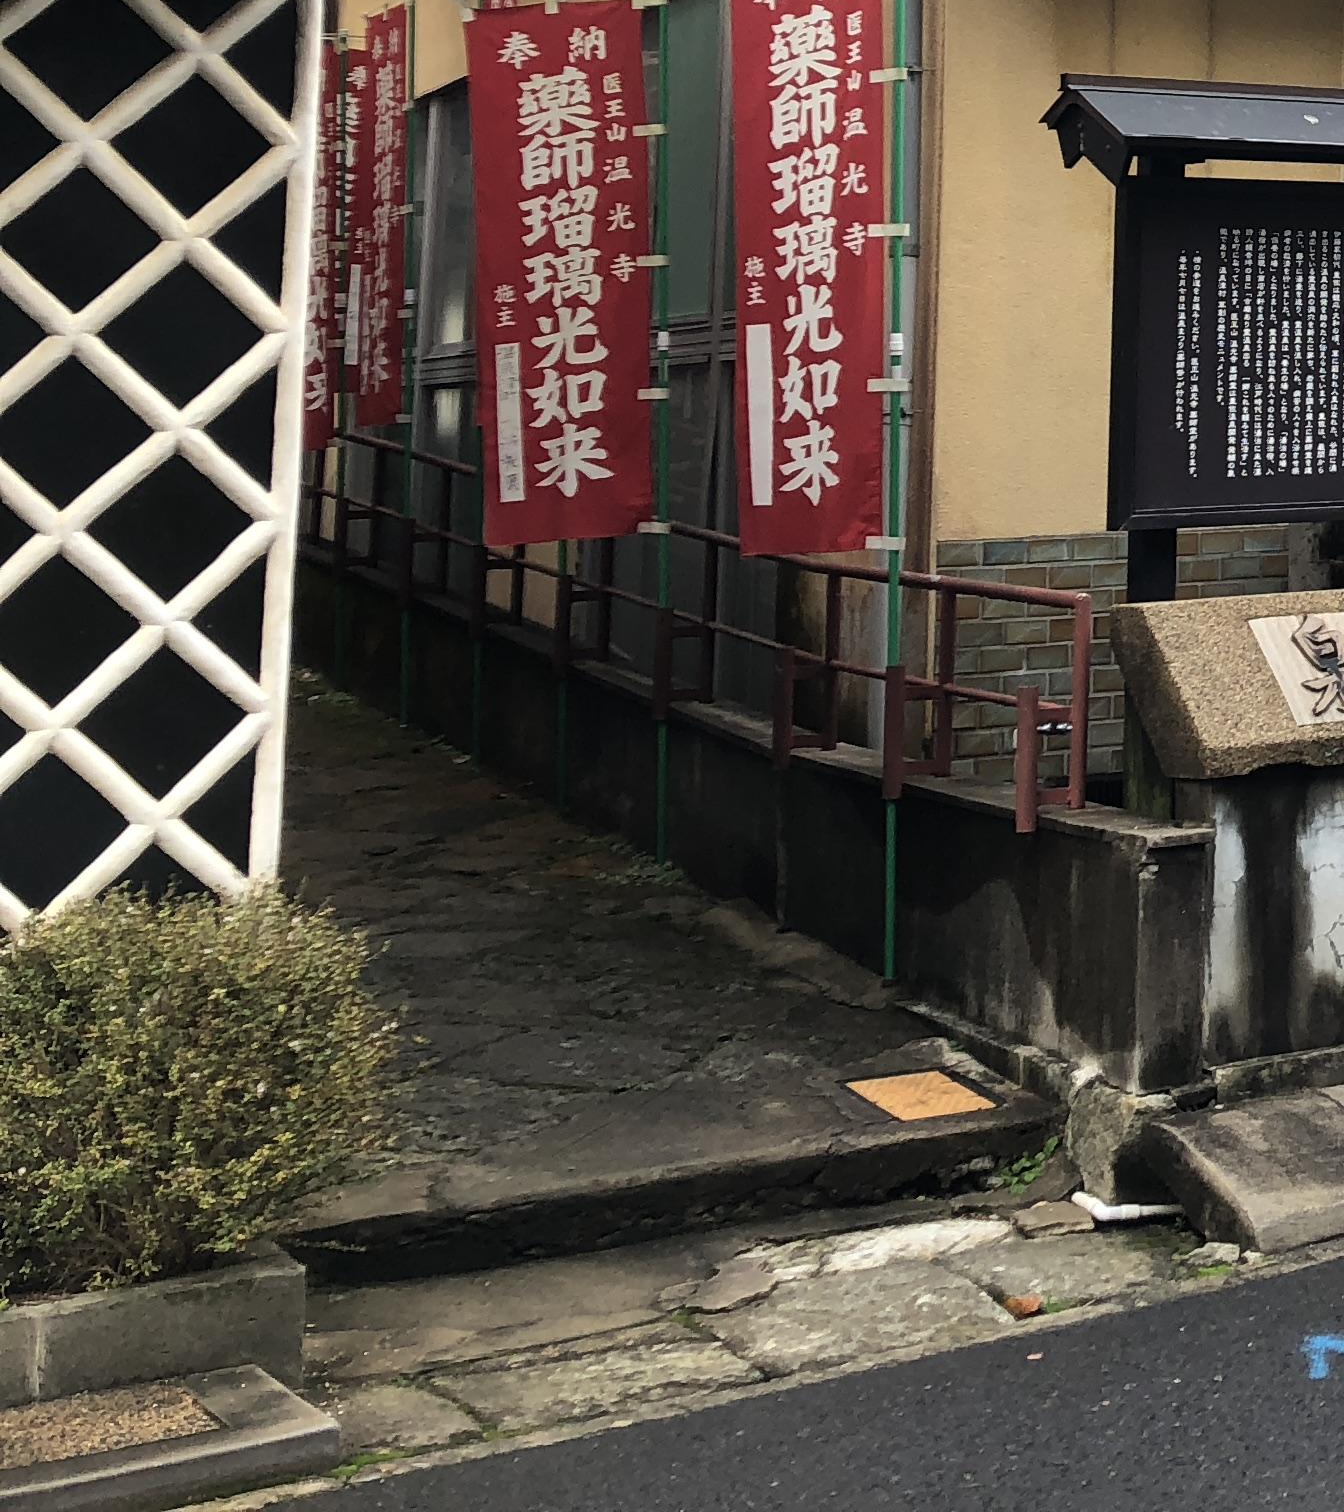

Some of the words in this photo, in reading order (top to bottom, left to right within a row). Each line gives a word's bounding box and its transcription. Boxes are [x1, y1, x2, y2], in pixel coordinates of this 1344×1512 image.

[496, 25, 607, 70] 奉納
[744, 255, 767, 306] 施主
[493, 284, 517, 328] 施主
